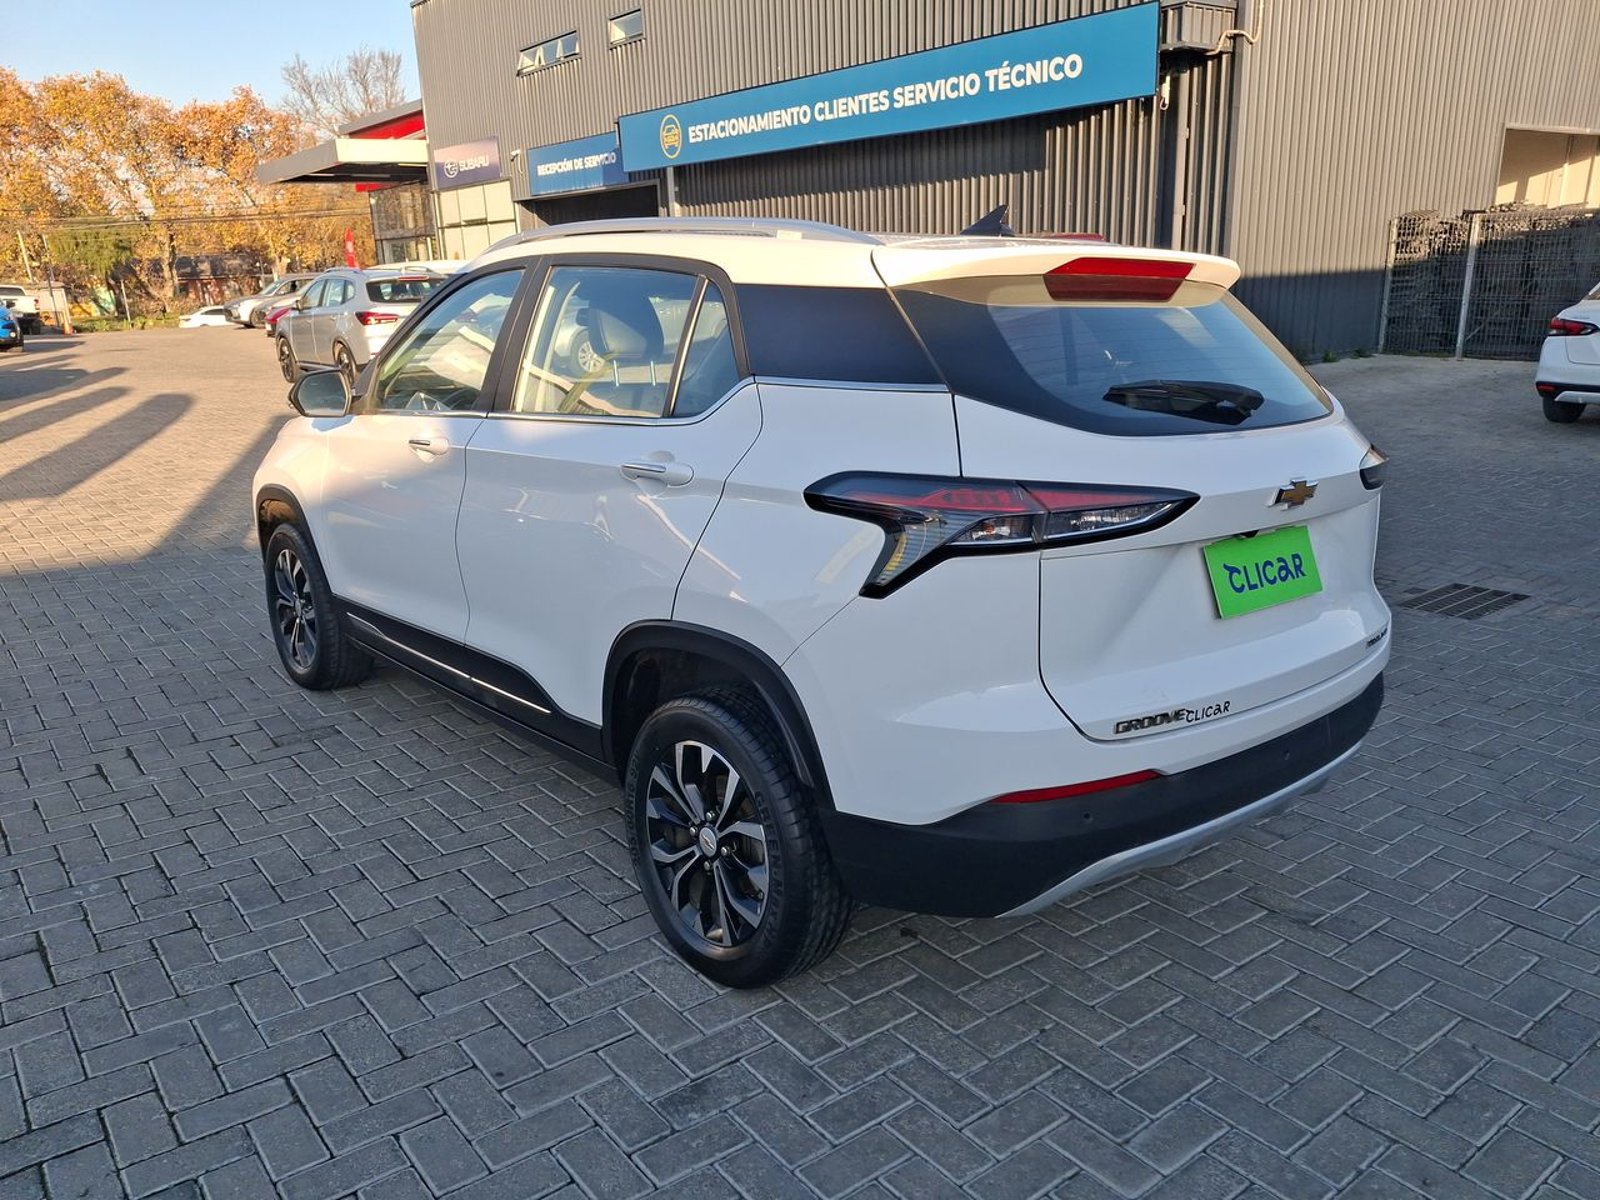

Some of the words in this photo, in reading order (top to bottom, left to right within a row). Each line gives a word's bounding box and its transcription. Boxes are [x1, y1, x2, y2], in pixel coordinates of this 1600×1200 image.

[688, 104, 811, 144] ESTACIONAMIENTO
[814, 89, 890, 122] CLIENTES
[893, 72, 981, 109] SERVICIO
[984, 53, 1083, 92] TÉCNICO
[459, 154, 490, 171] SUBARU
[537, 158, 573, 176] RECEPCIÓN
[574, 158, 584, 170] DE
[584, 152, 616, 168] SERVICIO
[1114, 708, 1186, 734] GROOVE
